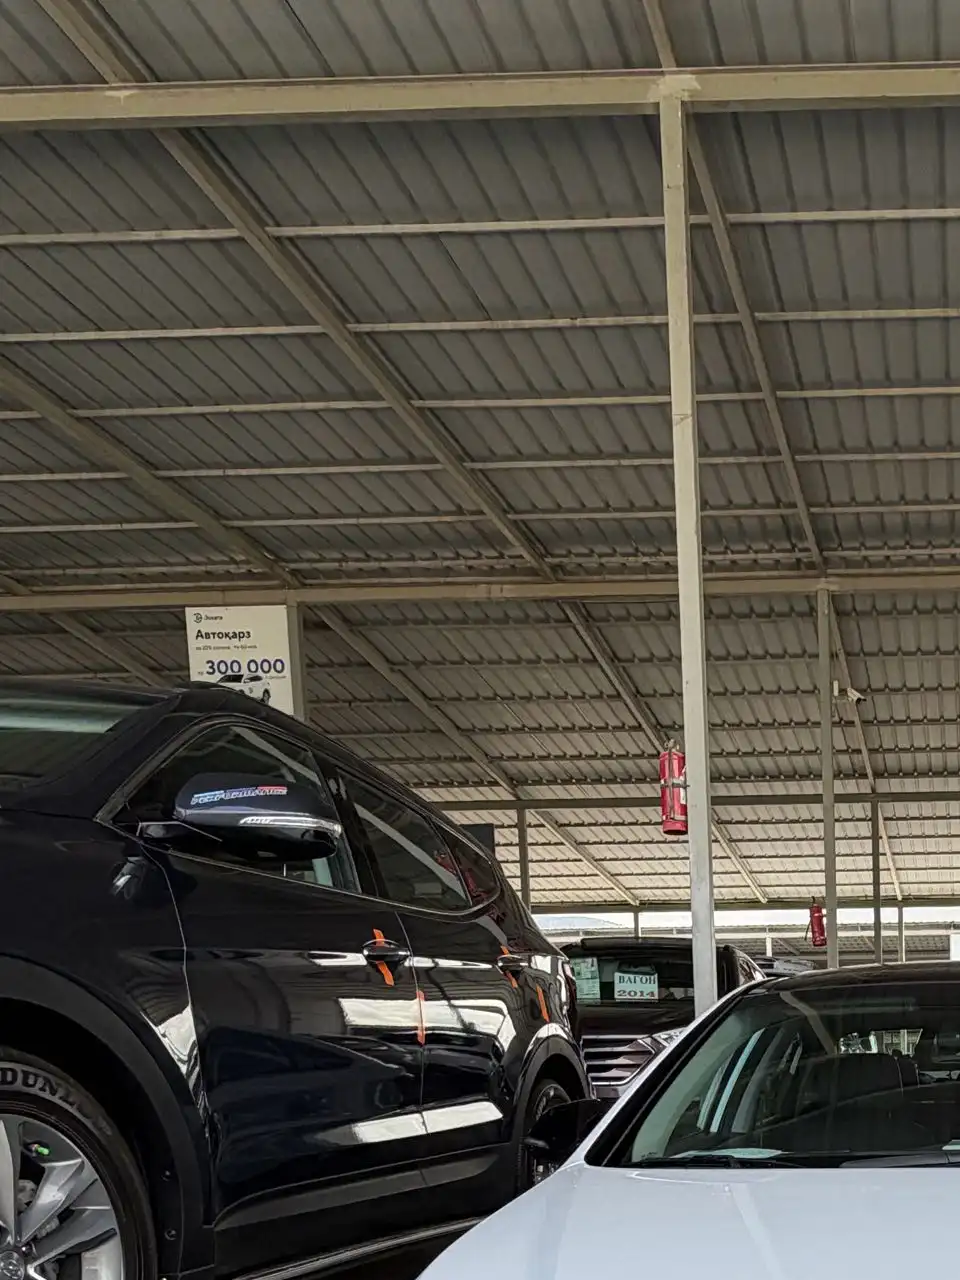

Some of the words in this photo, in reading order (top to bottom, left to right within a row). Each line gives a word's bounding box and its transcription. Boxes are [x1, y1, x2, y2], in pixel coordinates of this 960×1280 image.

[195, 629, 251, 642] Автоқарз
[206, 660, 242, 675] 300
[247, 658, 285, 674] 000
[618, 975, 656, 985] ВАГОН
[616, 989, 656, 998] 2014
